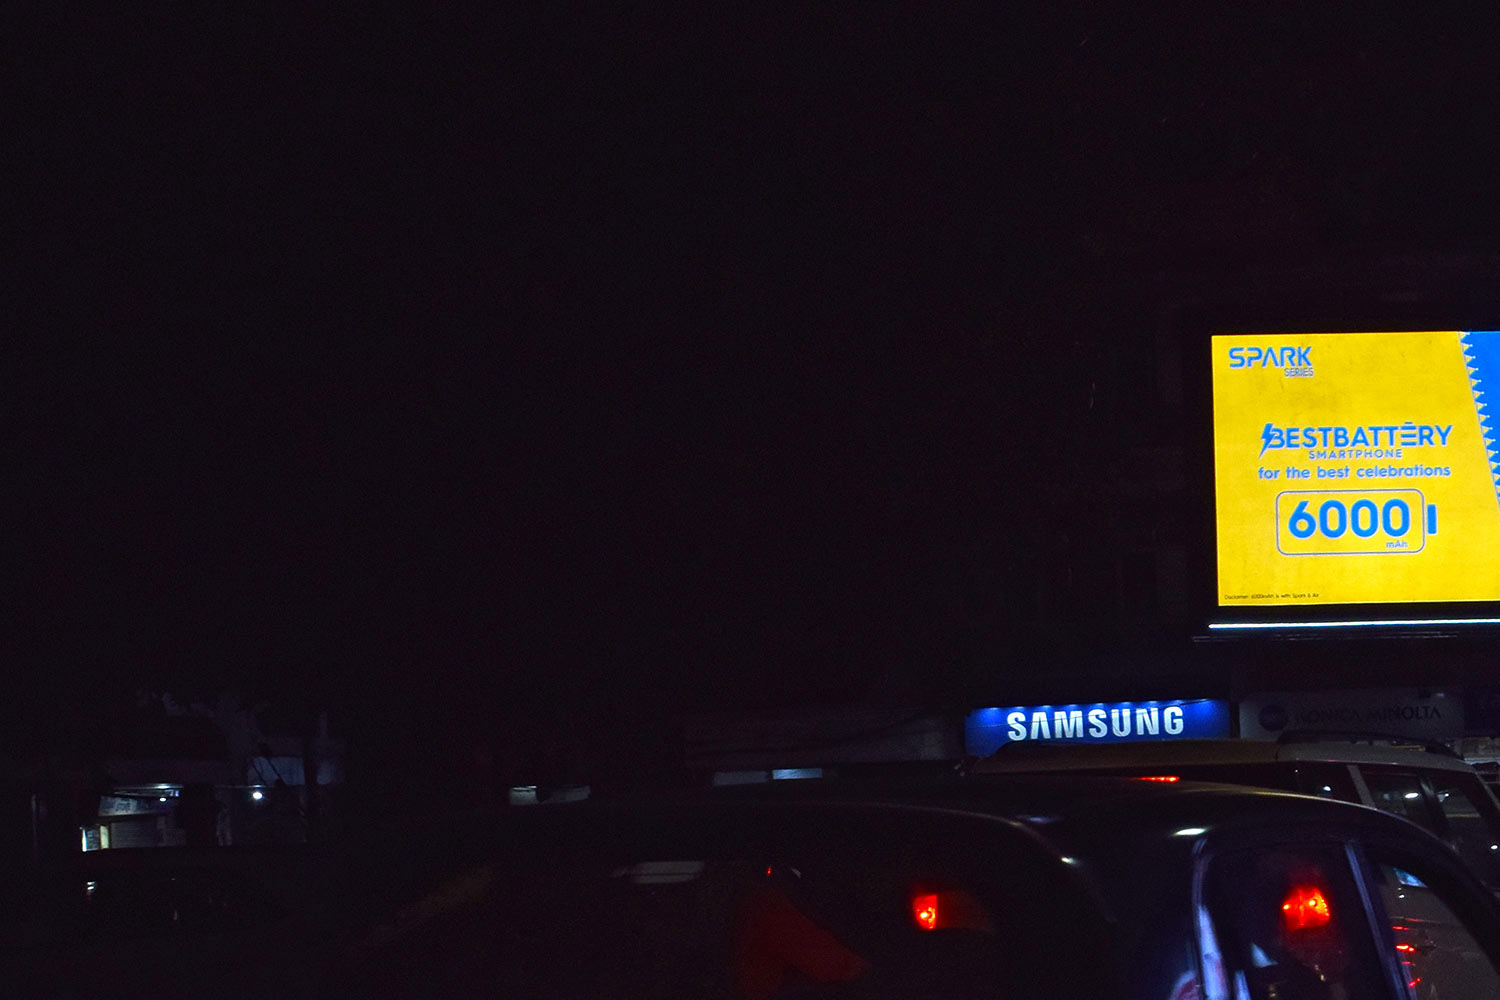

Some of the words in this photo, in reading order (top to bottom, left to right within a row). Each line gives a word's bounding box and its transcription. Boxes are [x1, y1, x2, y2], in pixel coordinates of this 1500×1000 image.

[1228, 346, 1312, 368] SPARK
[1284, 368, 1314, 378] SERIES
[1309, 449, 1403, 460] SMARTPHONE
[1258, 466, 1280, 480] for
[1286, 465, 1310, 478] the
[1317, 464, 1350, 478] best
[1356, 464, 1451, 477] celebrations
[1288, 498, 1410, 539] 6000
[1386, 540, 1408, 548] mAh
[1294, 710, 1360, 724] KONICA
[1366, 705, 1442, 722] MINOLTA
[1006, 705, 1184, 742] SAMSUNG
